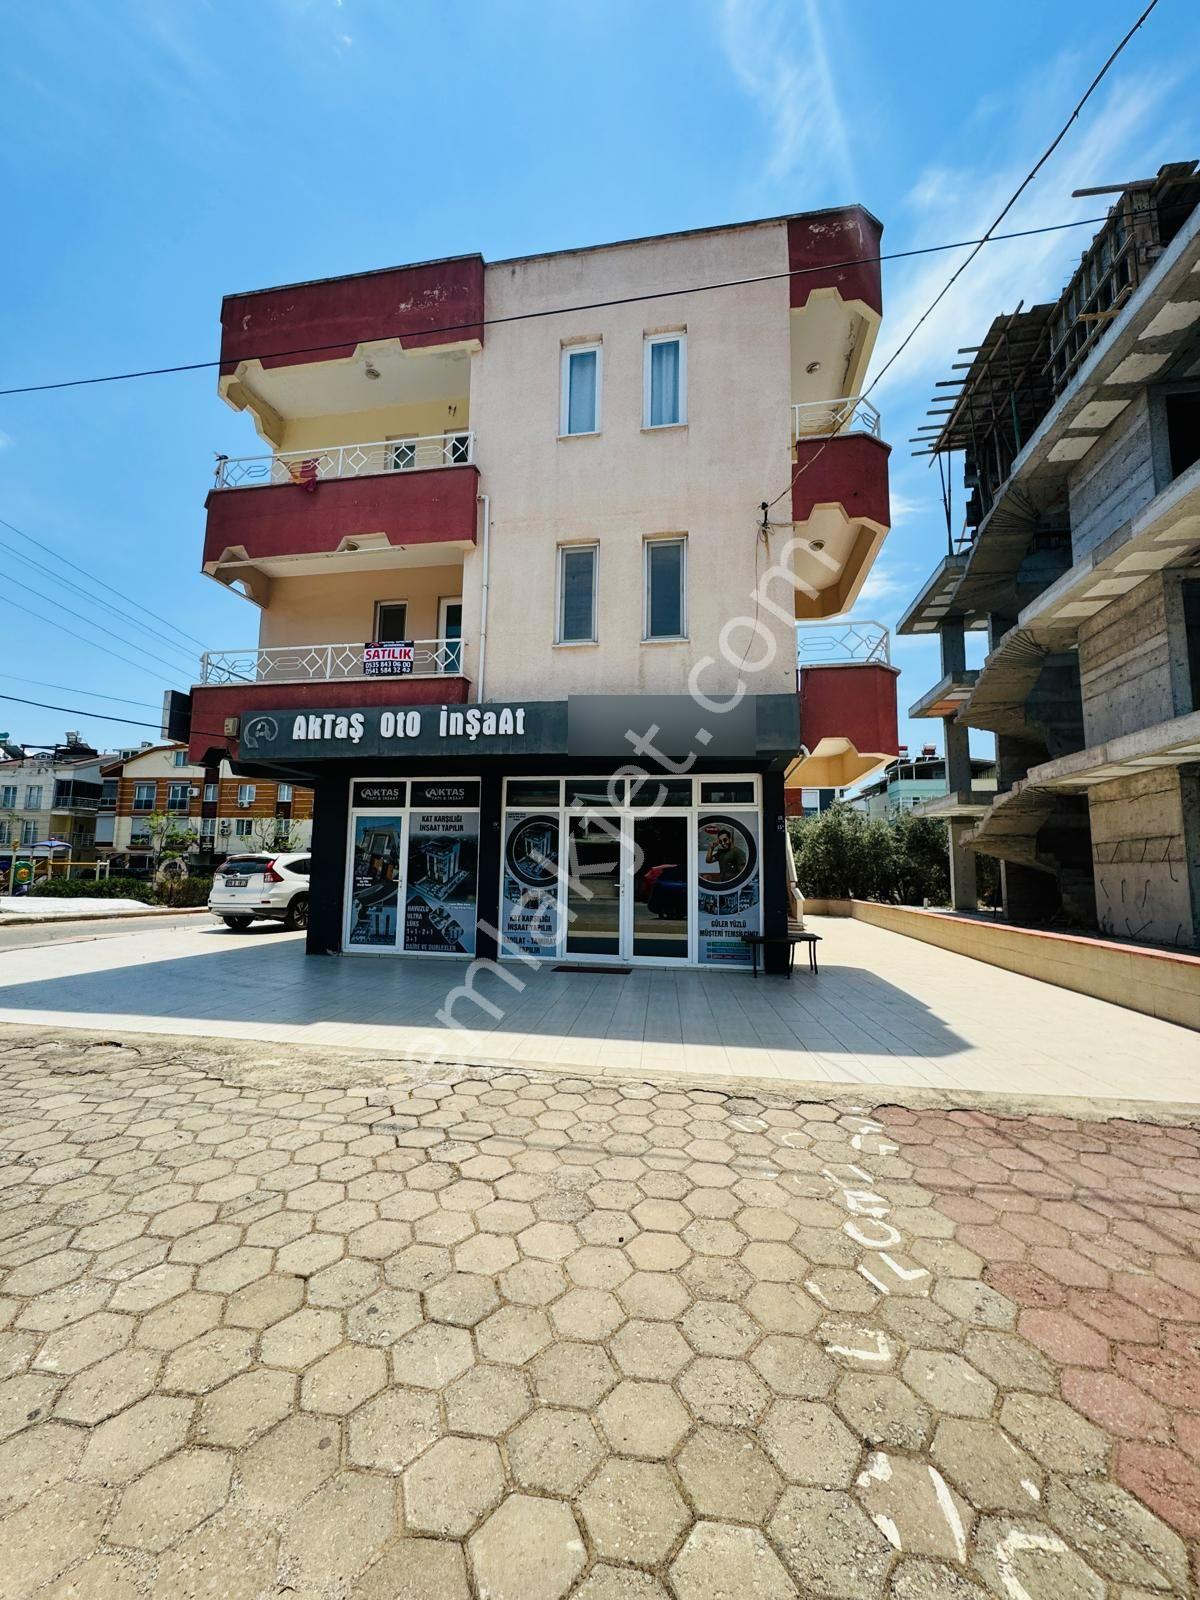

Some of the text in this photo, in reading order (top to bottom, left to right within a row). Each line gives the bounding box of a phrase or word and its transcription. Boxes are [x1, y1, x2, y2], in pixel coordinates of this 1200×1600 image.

[365, 648, 412, 661] SATILIK
[421, 814, 462, 823] KAT KARŞILIĞI
[442, 824, 464, 832] YAPILIR
[711, 919, 747, 928] GÜLER YÜZLÜ
